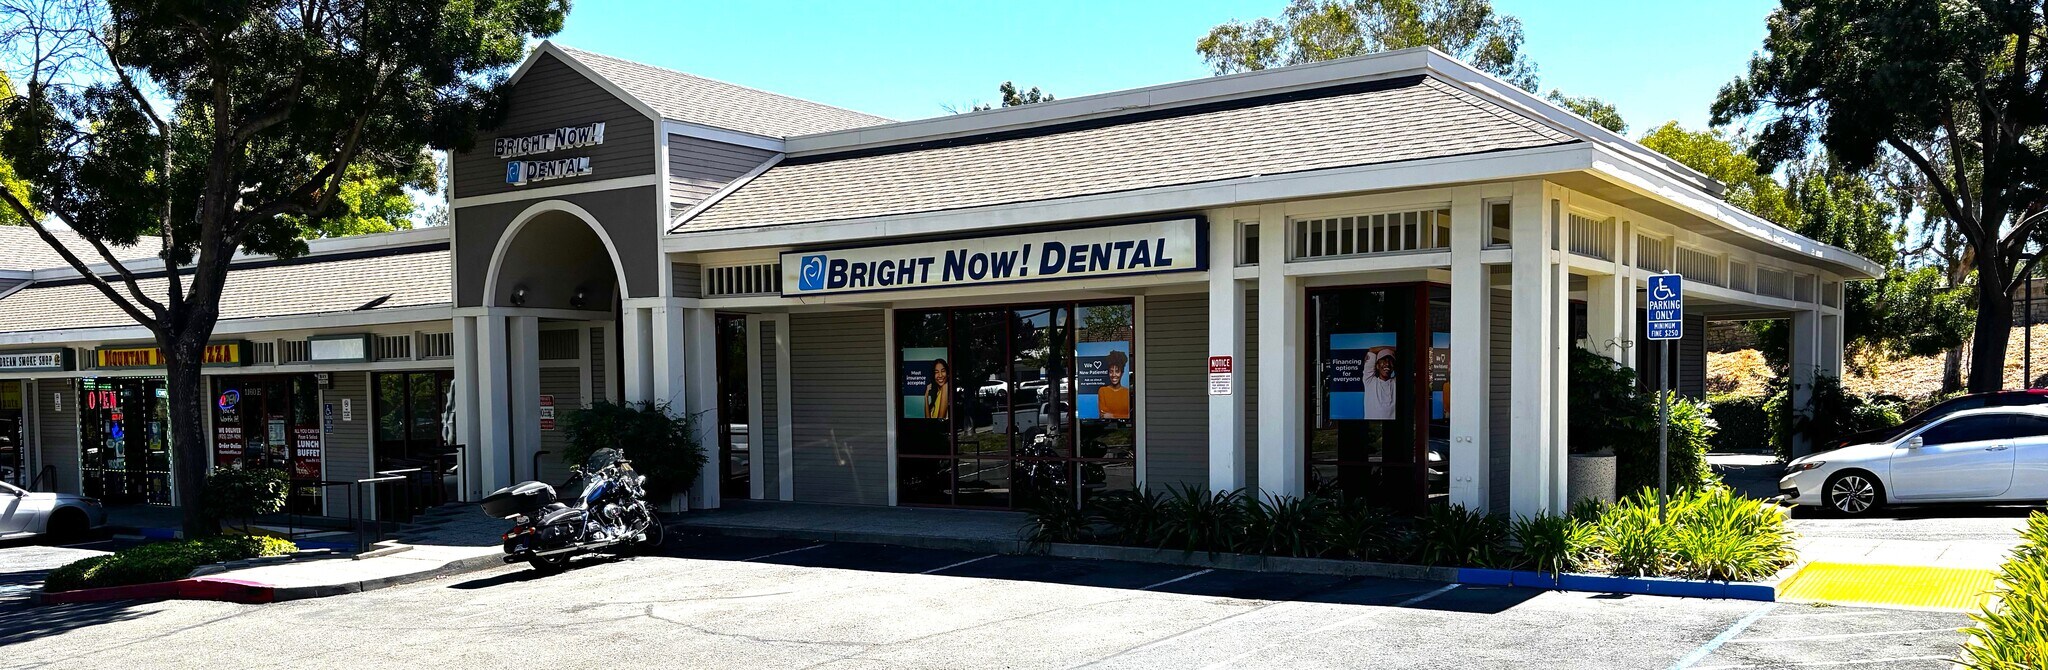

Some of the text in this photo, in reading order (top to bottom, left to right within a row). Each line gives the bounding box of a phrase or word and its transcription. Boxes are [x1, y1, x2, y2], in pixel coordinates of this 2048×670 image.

[495, 122, 601, 157] BRIGHT NOW!
[526, 157, 589, 180] DENTAL
[827, 238, 1173, 290] BRIGHT NOW! DENTAL
[1649, 300, 1681, 310] PARKING
[1655, 310, 1674, 320] ONLY
[1654, 322, 1676, 330] MINIMUM
[1664, 329, 1679, 337] $250
[18, 356, 37, 367] SMOKE
[38, 355, 53, 366] SHOP
[104, 349, 150, 367] MOUNTAIN
[1211, 358, 1231, 368] NOTICE
[1332, 358, 1362, 366] Financing
[88, 390, 118, 409] OPEN
[297, 440, 320, 448] LUNCH
[297, 449, 321, 457] BUFFET
